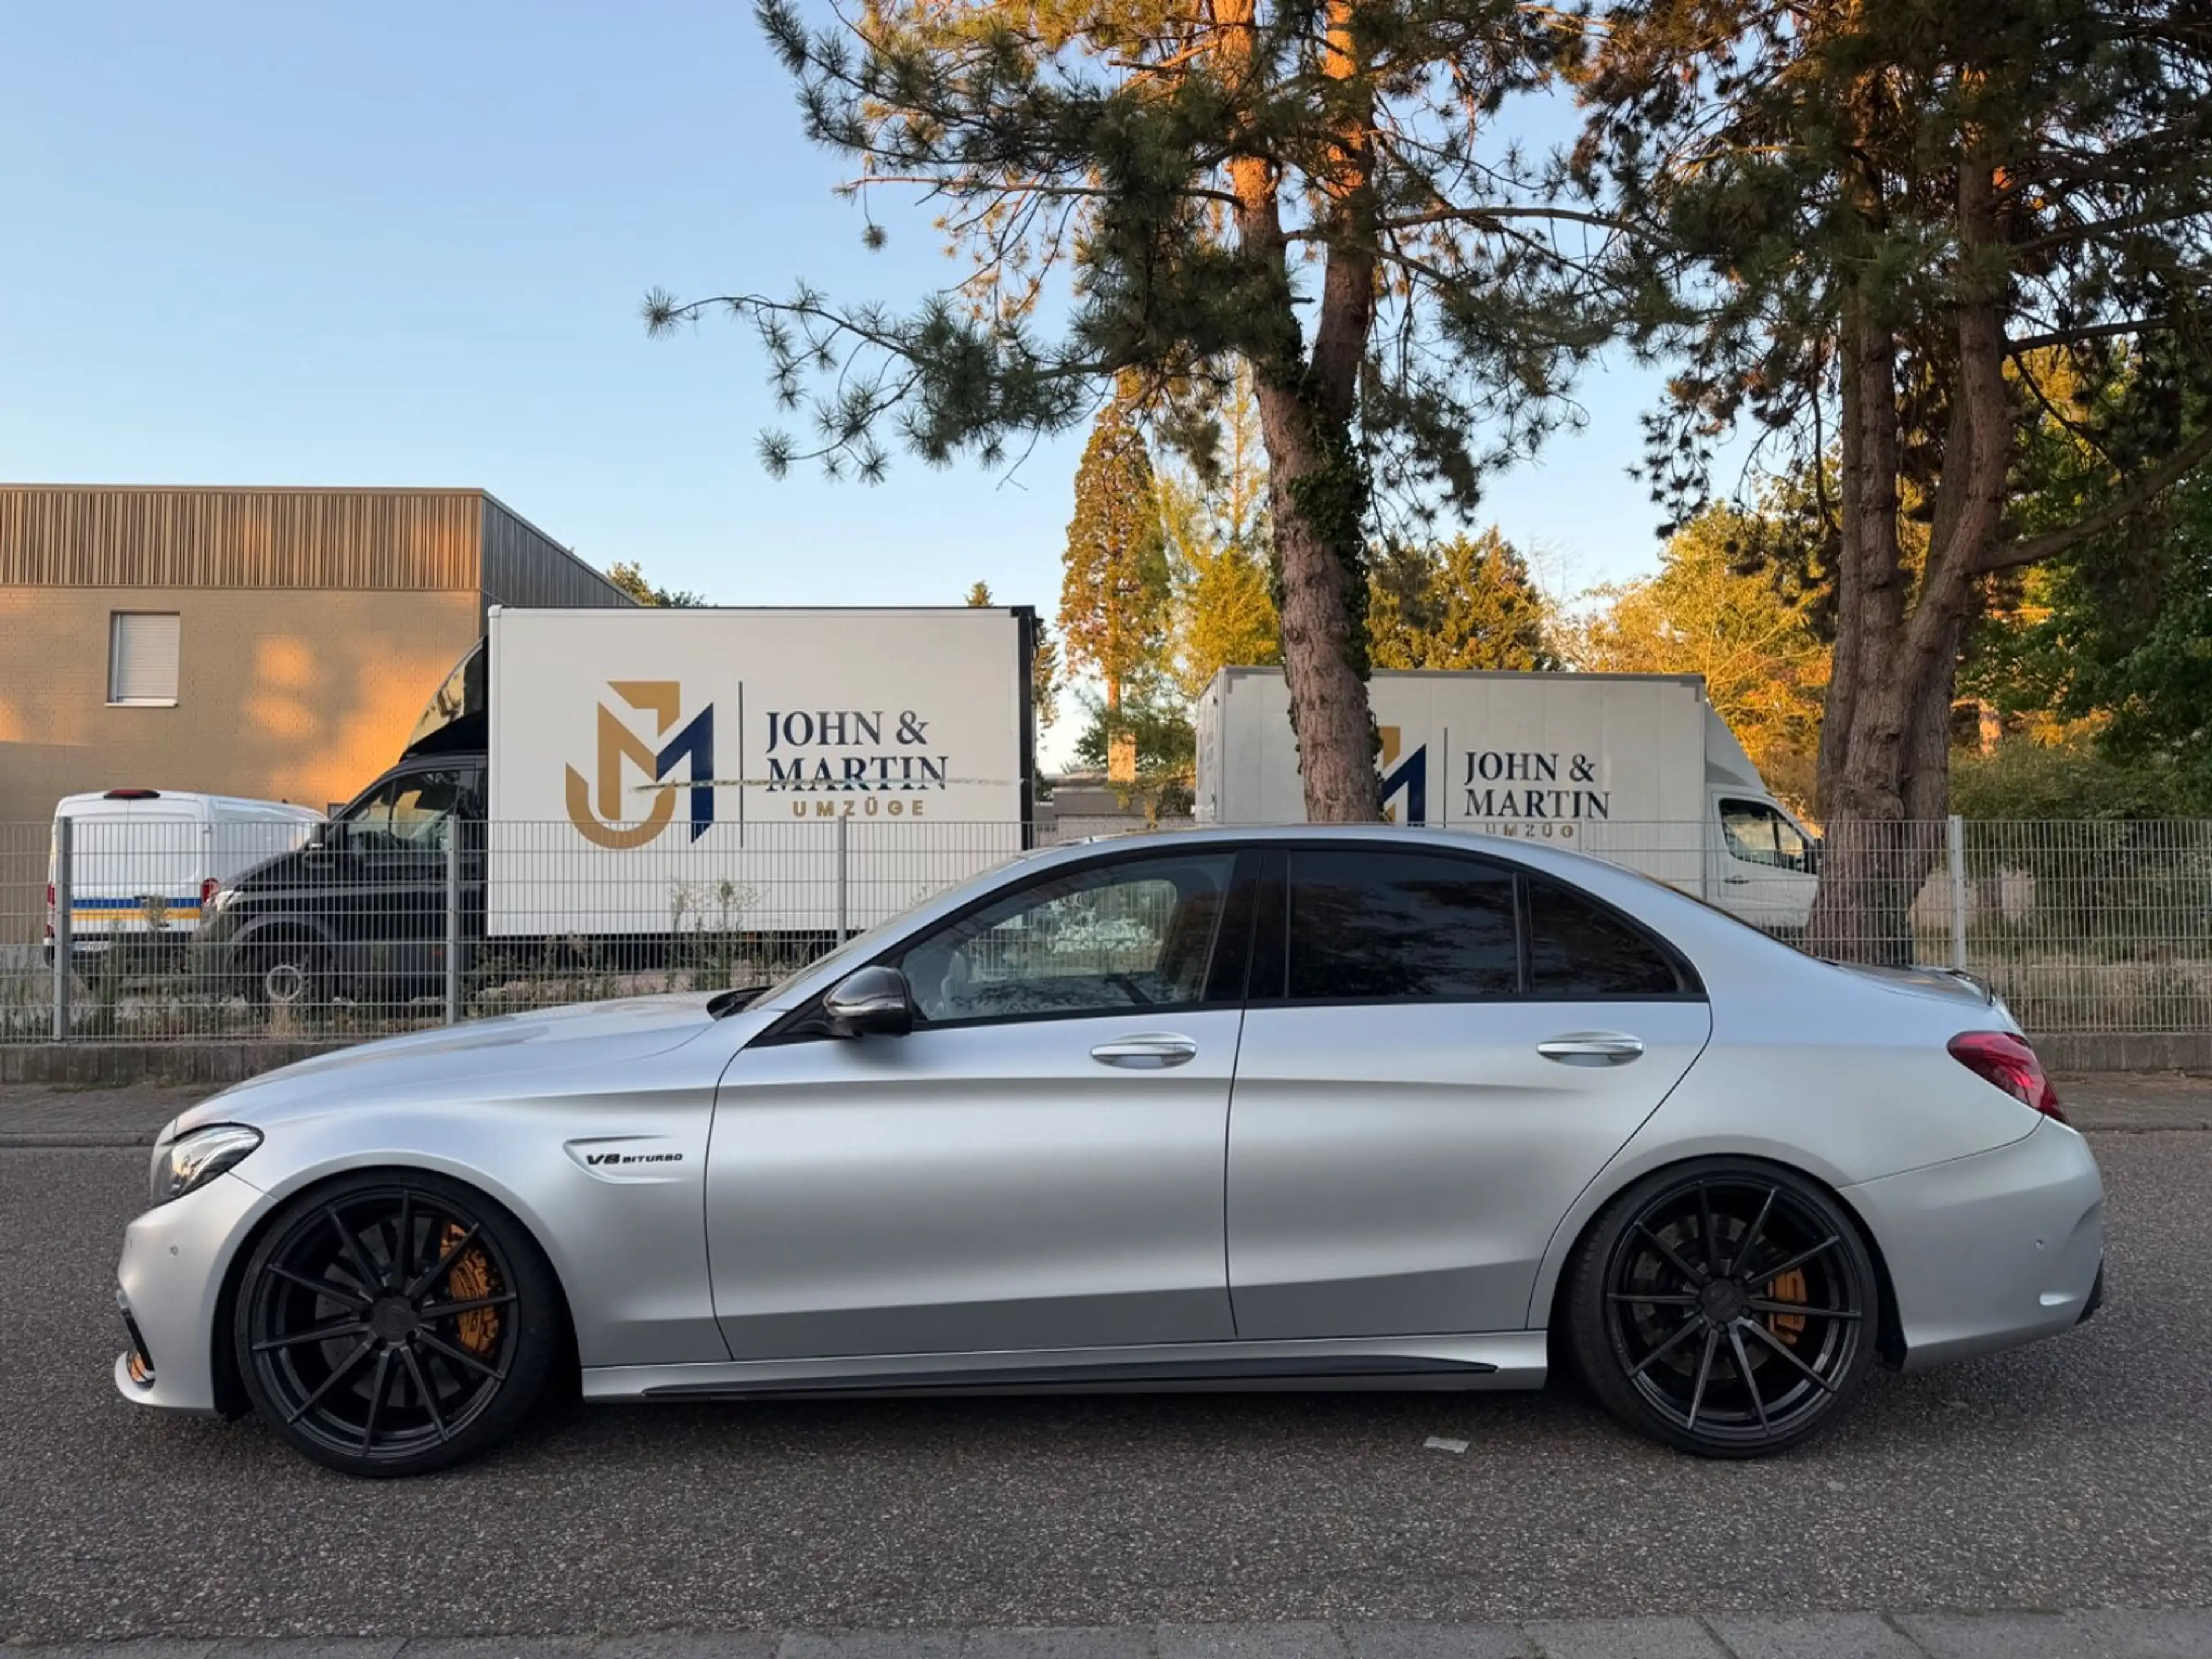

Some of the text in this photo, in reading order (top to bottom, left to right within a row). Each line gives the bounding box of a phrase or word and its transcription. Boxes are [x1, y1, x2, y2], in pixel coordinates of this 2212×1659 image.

[765, 710, 929, 753] JOHN &
[766, 756, 949, 791] MARTIN
[1464, 751, 1595, 786] JOHN &
[793, 797, 924, 817] UMZÜGE
[1464, 788, 1611, 819] MARTIN
[586, 1153, 683, 1165] V8 BITURBO
